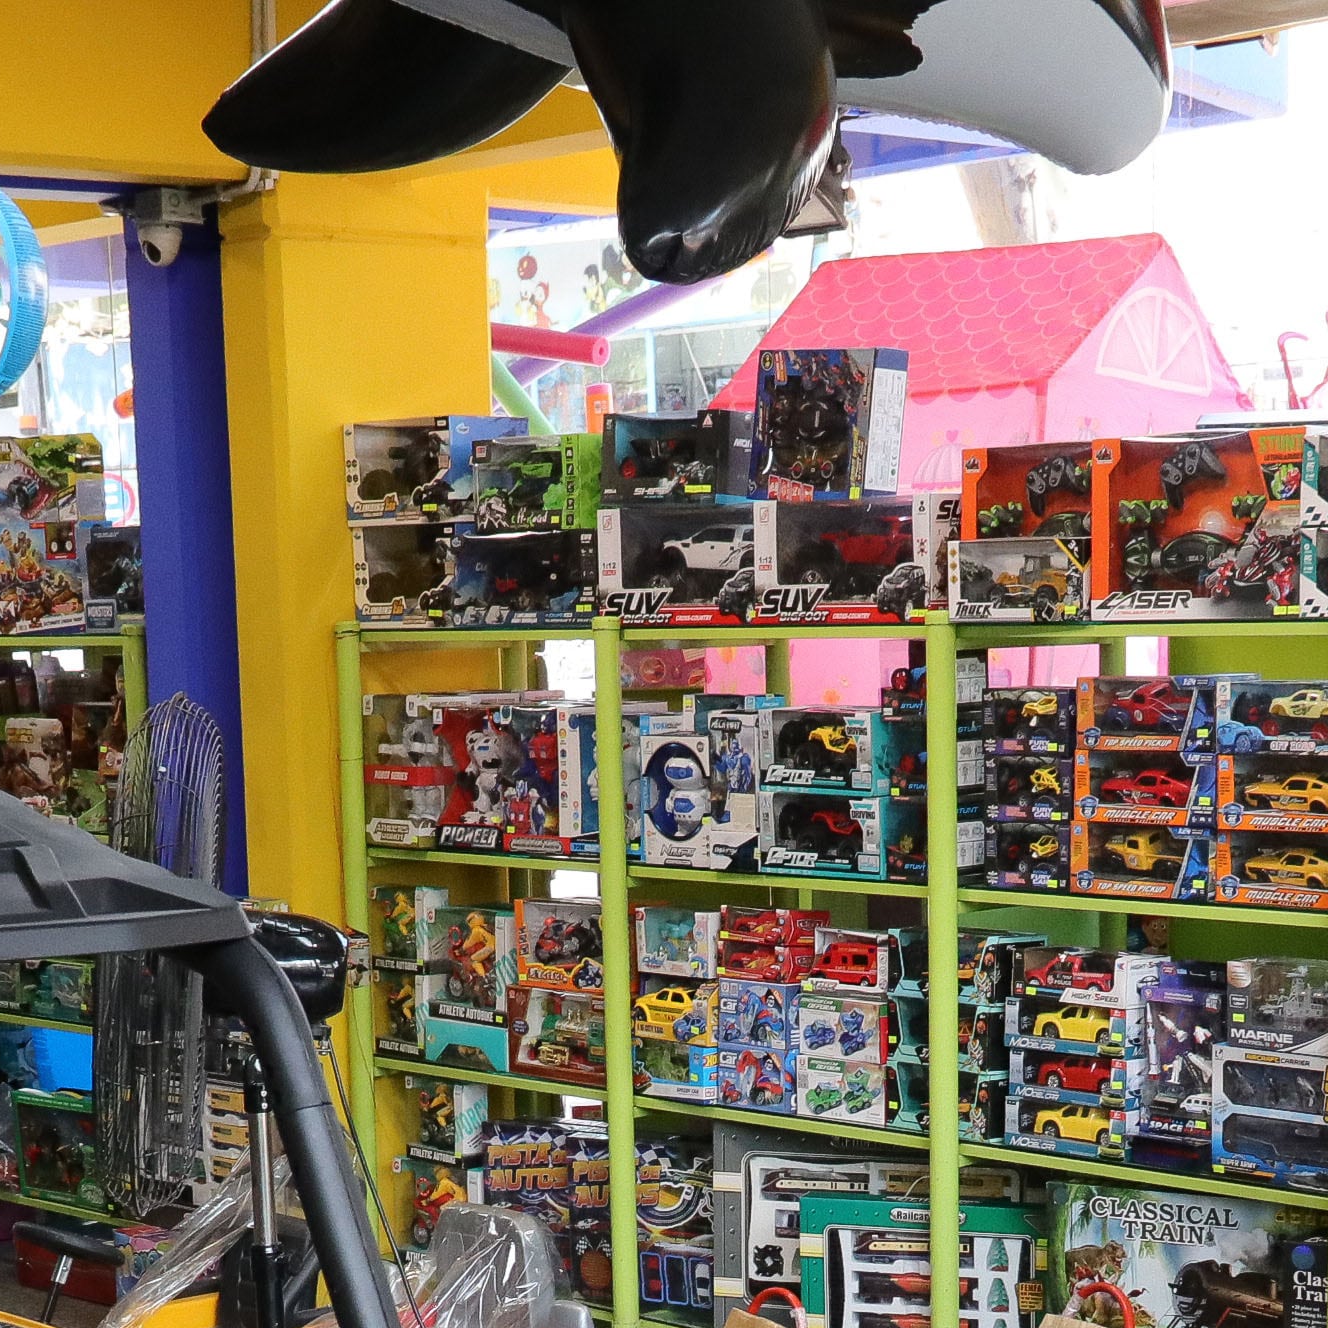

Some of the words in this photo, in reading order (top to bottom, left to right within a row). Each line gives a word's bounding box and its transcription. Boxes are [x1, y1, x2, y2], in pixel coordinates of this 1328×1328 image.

[602, 562, 617, 570] 1:12
[759, 556, 773, 564] 1:12
[604, 590, 672, 616] SUV
[762, 585, 829, 615] SUV
[1095, 590, 1192, 617] LASER
[779, 612, 829, 622] BIGFOOT
[955, 602, 994, 618] TRUCK
[622, 613, 672, 623] BIGFOOT
[1104, 739, 1119, 747] TOP
[1120, 739, 1143, 747] SPEED
[1144, 739, 1172, 747] PICKUP
[440, 826, 498, 847] PIONEER
[1097, 882, 1112, 890] TOP
[1113, 883, 1136, 891] SPEED
[1137, 885, 1166, 893] PICKUP
[438, 1004, 465, 1018] ATHLETIC
[721, 997, 737, 1011] Car
[1231, 1028, 1294, 1044] MARINE
[720, 1050, 737, 1065] Car
[1280, 1058, 1311, 1067] CARRIER
[1149, 1119, 1183, 1132] SPACE
[410, 1146, 432, 1159] ATHLETIC
[487, 1143, 551, 1167] PISTA
[489, 1168, 570, 1191] AUTOS
[1089, 1196, 1239, 1228] CLASSICAL
[1121, 1219, 1206, 1246] TRAIN
